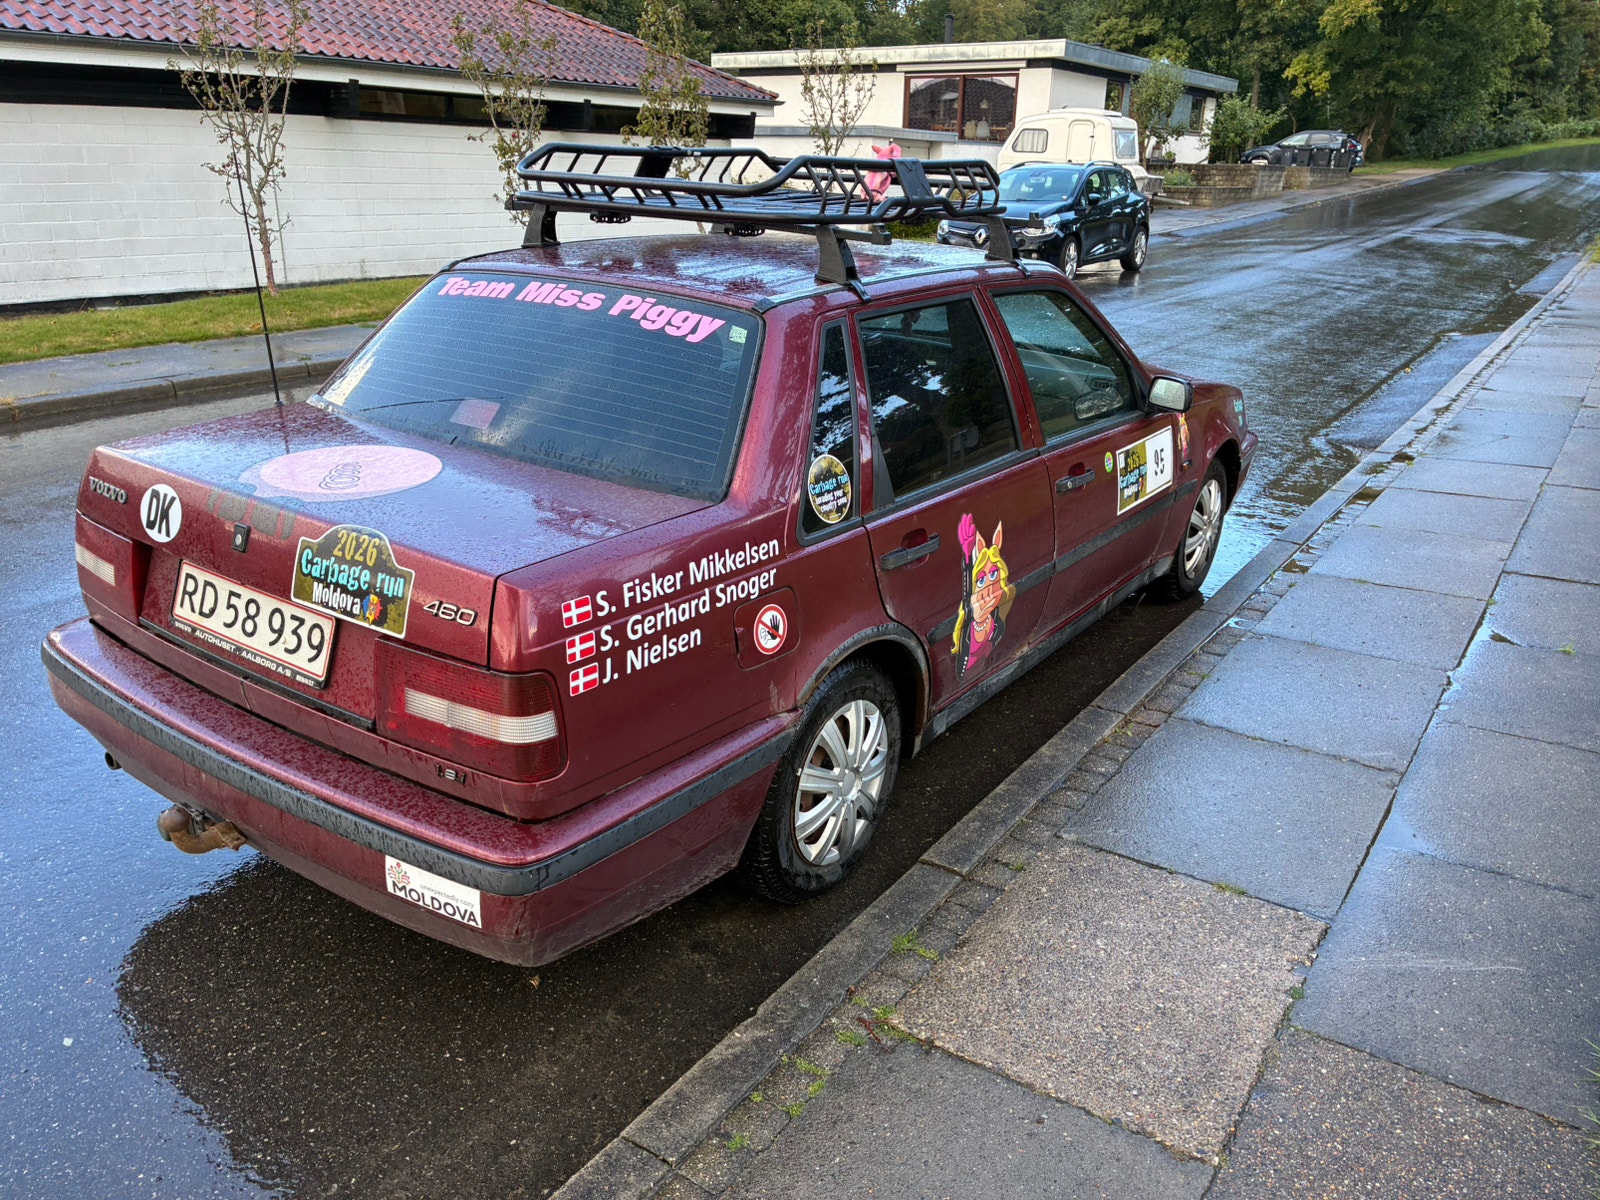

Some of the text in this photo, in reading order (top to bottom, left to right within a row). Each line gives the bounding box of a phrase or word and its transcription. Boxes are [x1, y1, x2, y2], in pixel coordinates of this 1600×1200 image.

[438, 277, 726, 343] Team Miss Piggy
[89, 476, 127, 504] VOLVO
[146, 488, 177, 538] DK
[301, 548, 404, 598] Carbage run
[333, 529, 380, 567] 2026
[312, 582, 361, 615] Moldova
[596, 538, 779, 617] S. Fisker Mikkelsen
[180, 572, 325, 663] RD 58 939
[423, 600, 477, 626] 460
[600, 567, 777, 652] S. Gerhard Snoger
[195, 630, 235, 652] AUTOHUSET
[241, 650, 277, 671] AALBORG
[277, 666, 291, 677] A/S
[602, 628, 701, 684] J. Nielsen
[392, 880, 479, 926] MOLDOVA
